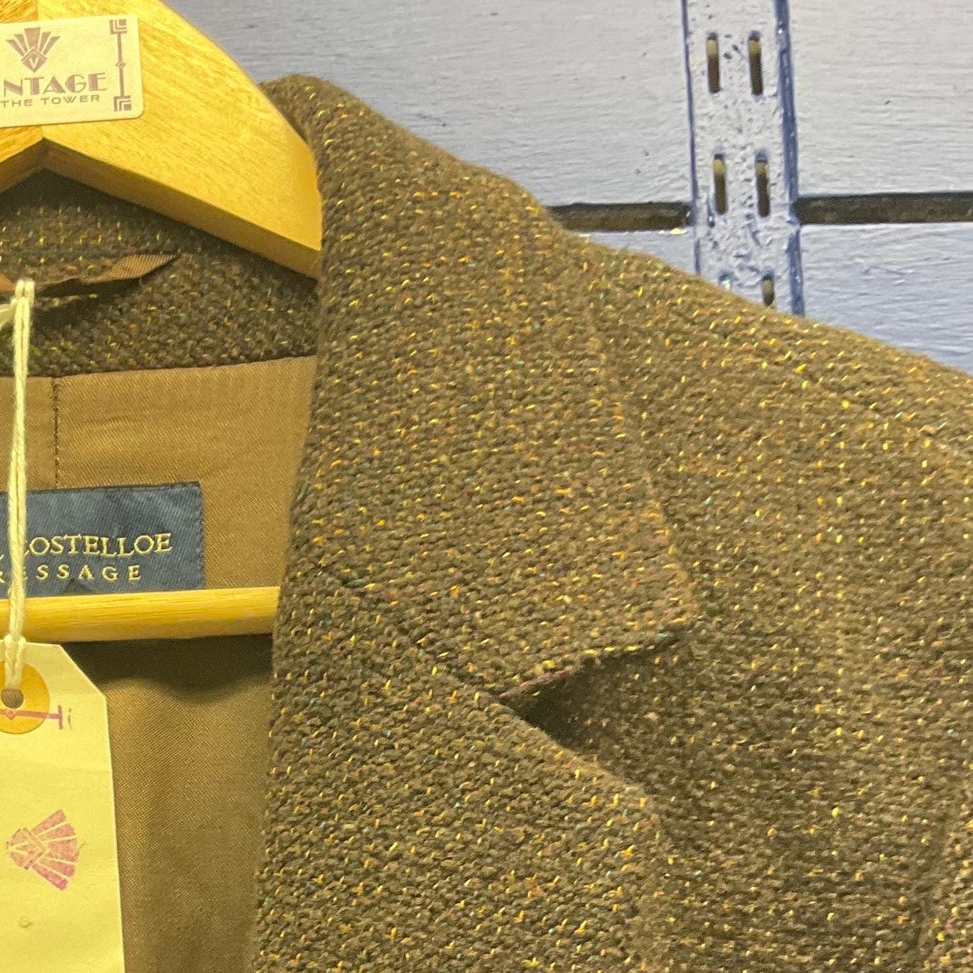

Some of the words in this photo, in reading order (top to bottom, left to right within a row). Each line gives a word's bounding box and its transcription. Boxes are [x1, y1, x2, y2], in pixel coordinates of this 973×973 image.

[2, 99, 33, 109] THE
[40, 94, 100, 106] TOWER
[23, 532, 173, 558] OSTELLOE
